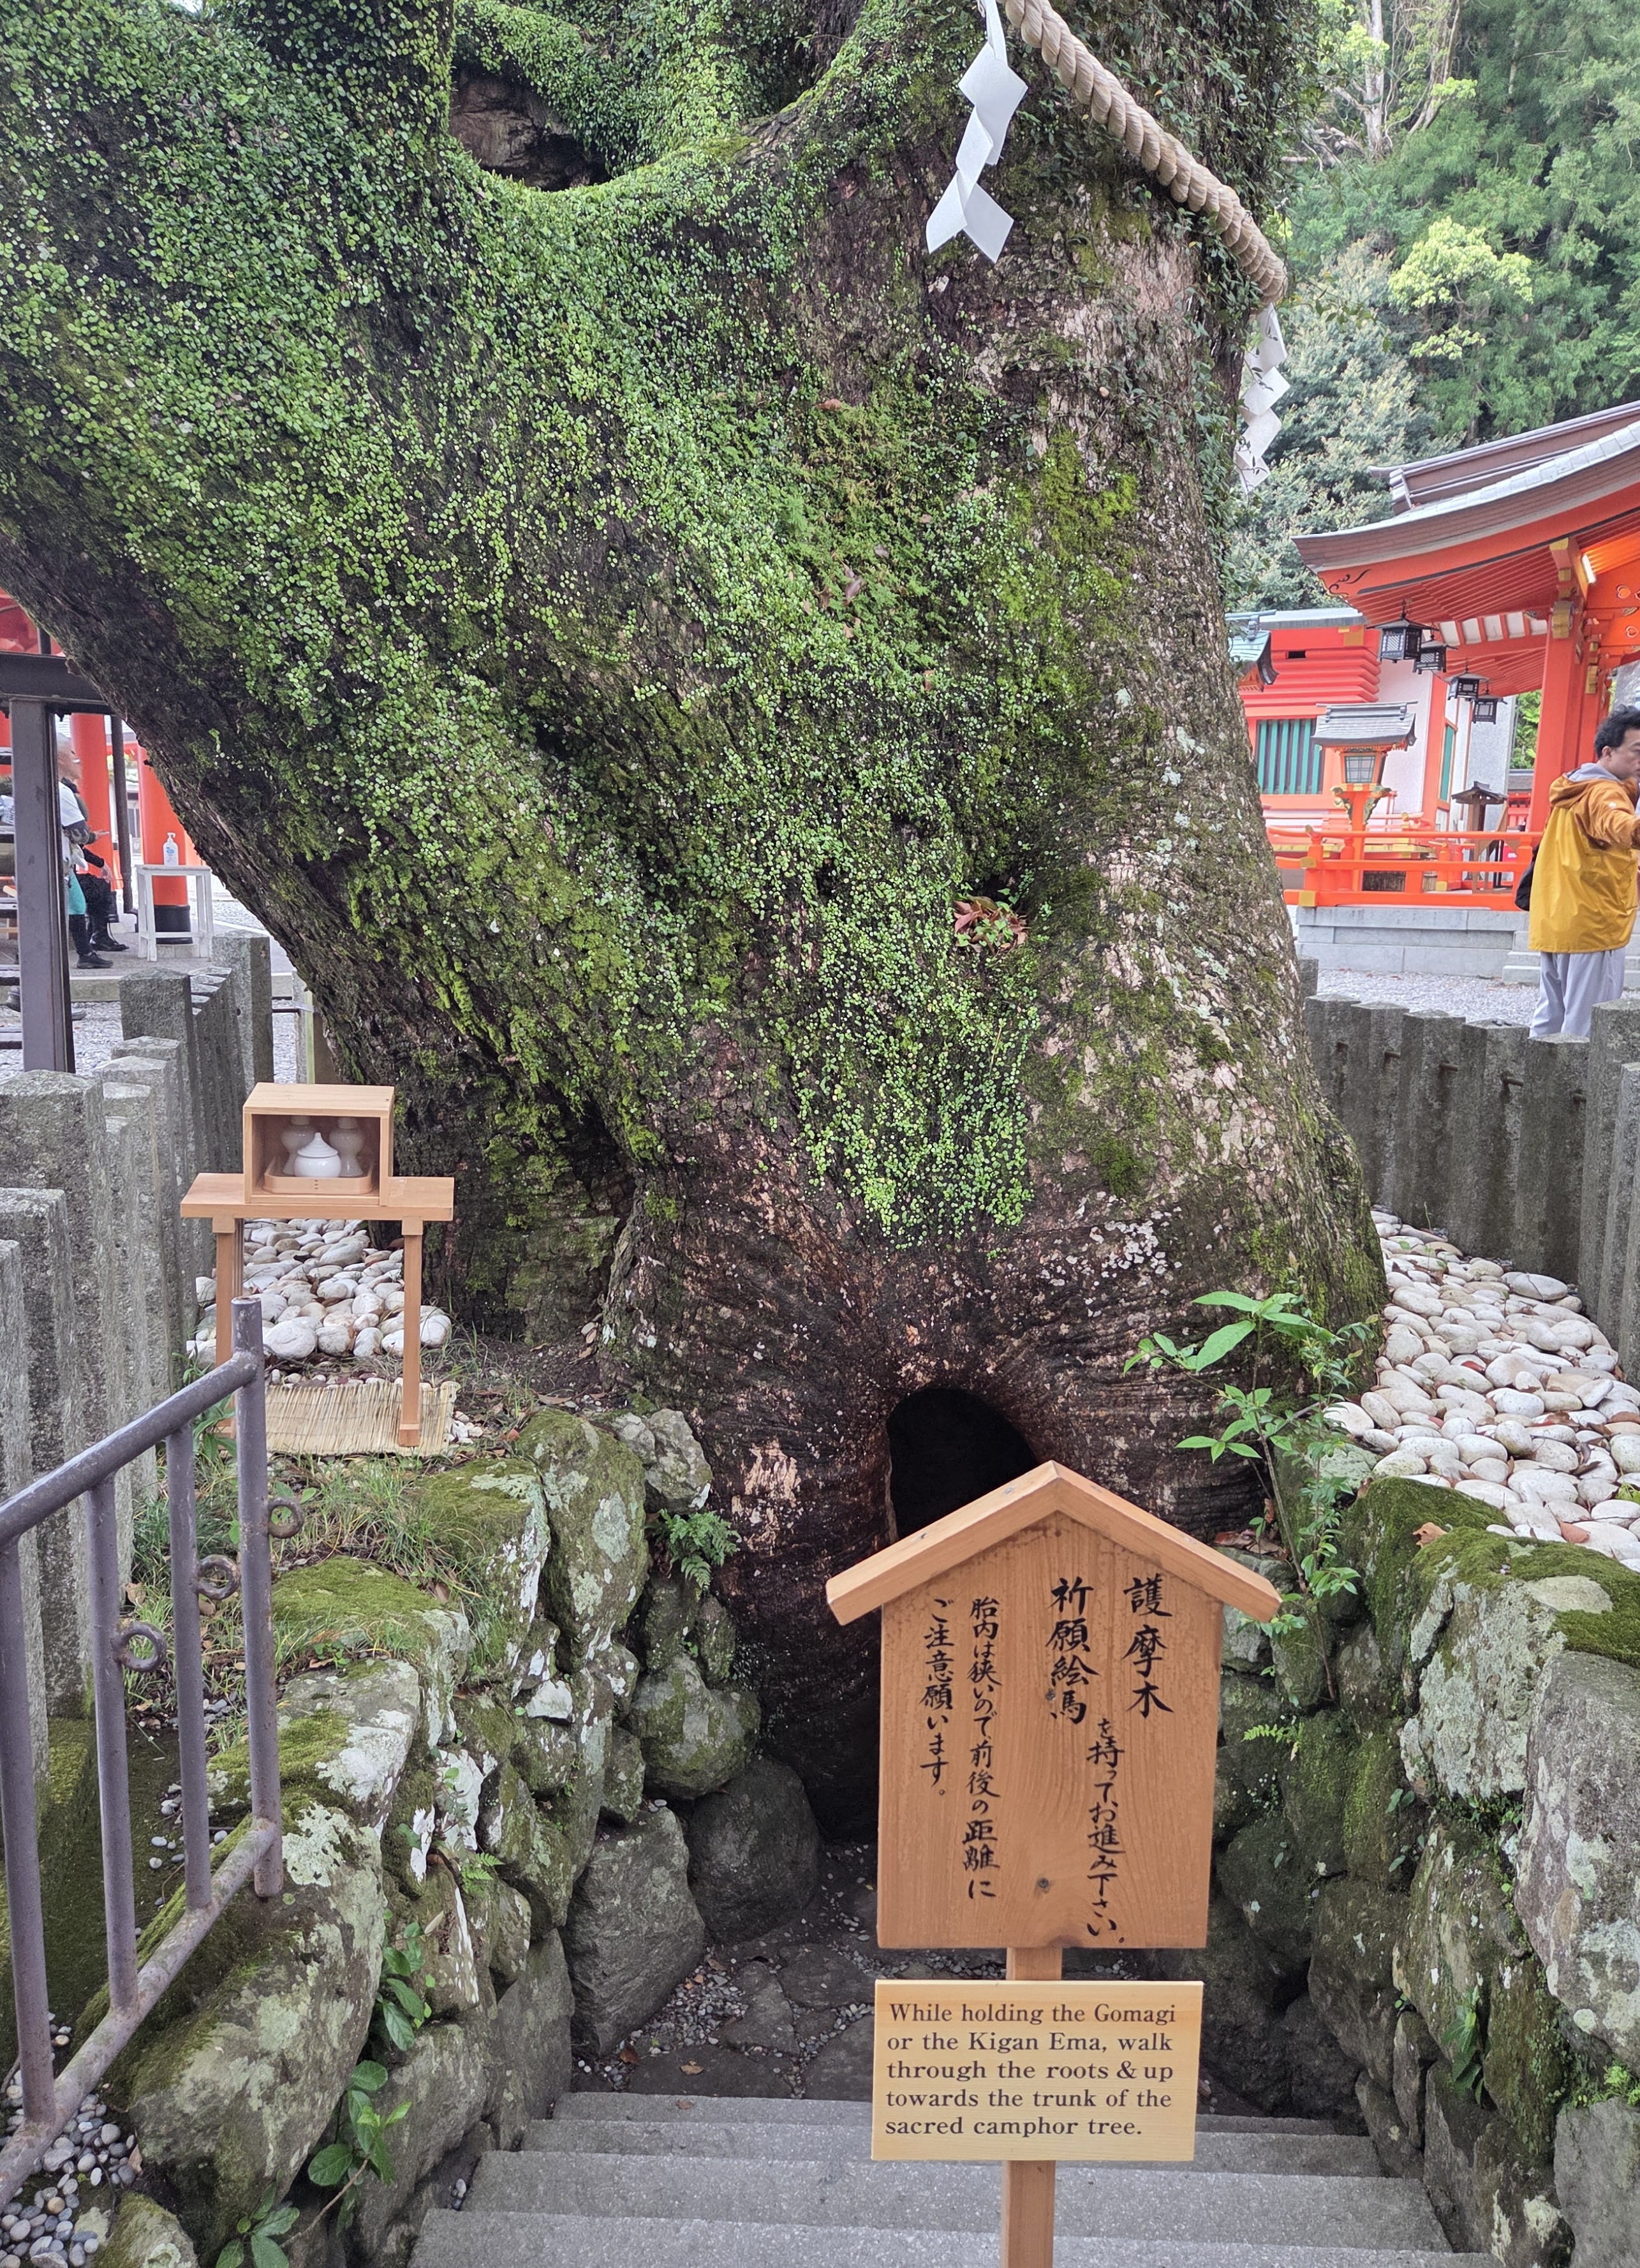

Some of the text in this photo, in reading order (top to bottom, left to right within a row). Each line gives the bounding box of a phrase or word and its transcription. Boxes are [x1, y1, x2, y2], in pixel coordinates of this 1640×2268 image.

[1045, 1576, 1100, 1726] 祈願絵馬
[1121, 1572, 1174, 1719] 護摩木
[919, 1597, 956, 1797] ご注意願います。
[889, 2003, 1176, 2026] While holding the Gomagi
[887, 2031, 1174, 2054] or the Kigan Ema, walk
[886, 2060, 1174, 2083] through the roots & up
[885, 2088, 1172, 2108] towards the trunk of the
[885, 2116, 1142, 2139] sacred camphor tree.
